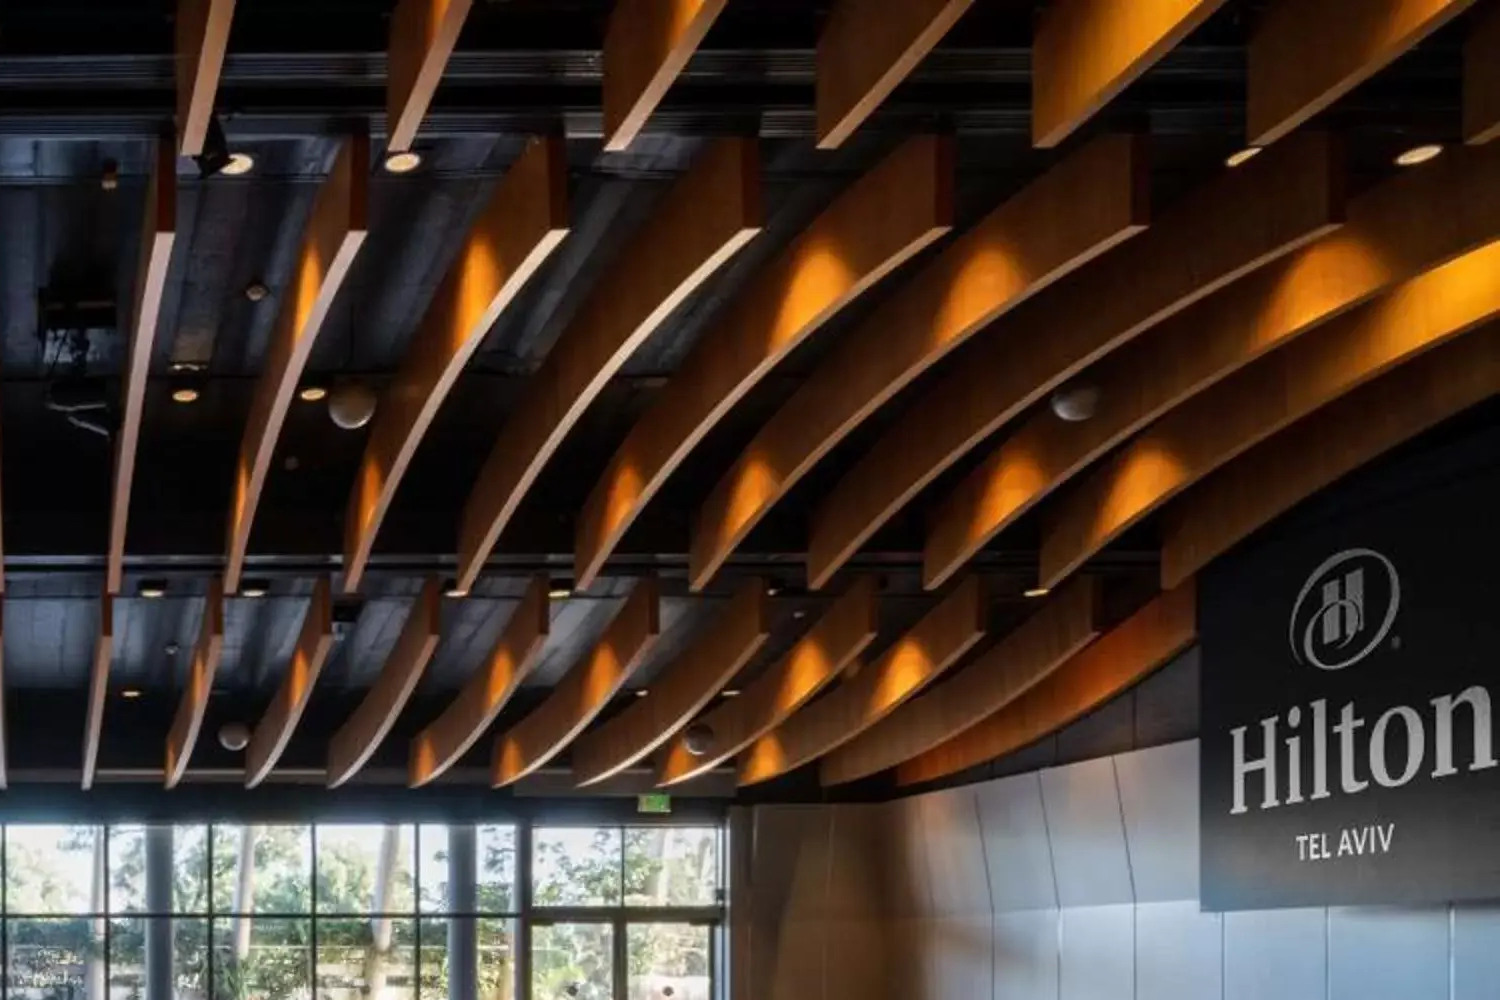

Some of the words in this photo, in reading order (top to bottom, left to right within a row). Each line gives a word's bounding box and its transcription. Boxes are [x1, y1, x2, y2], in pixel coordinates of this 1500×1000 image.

[1229, 685, 1498, 815] Hilton
[1295, 832, 1332, 862] TEL
[1336, 822, 1395, 858] AVIV
